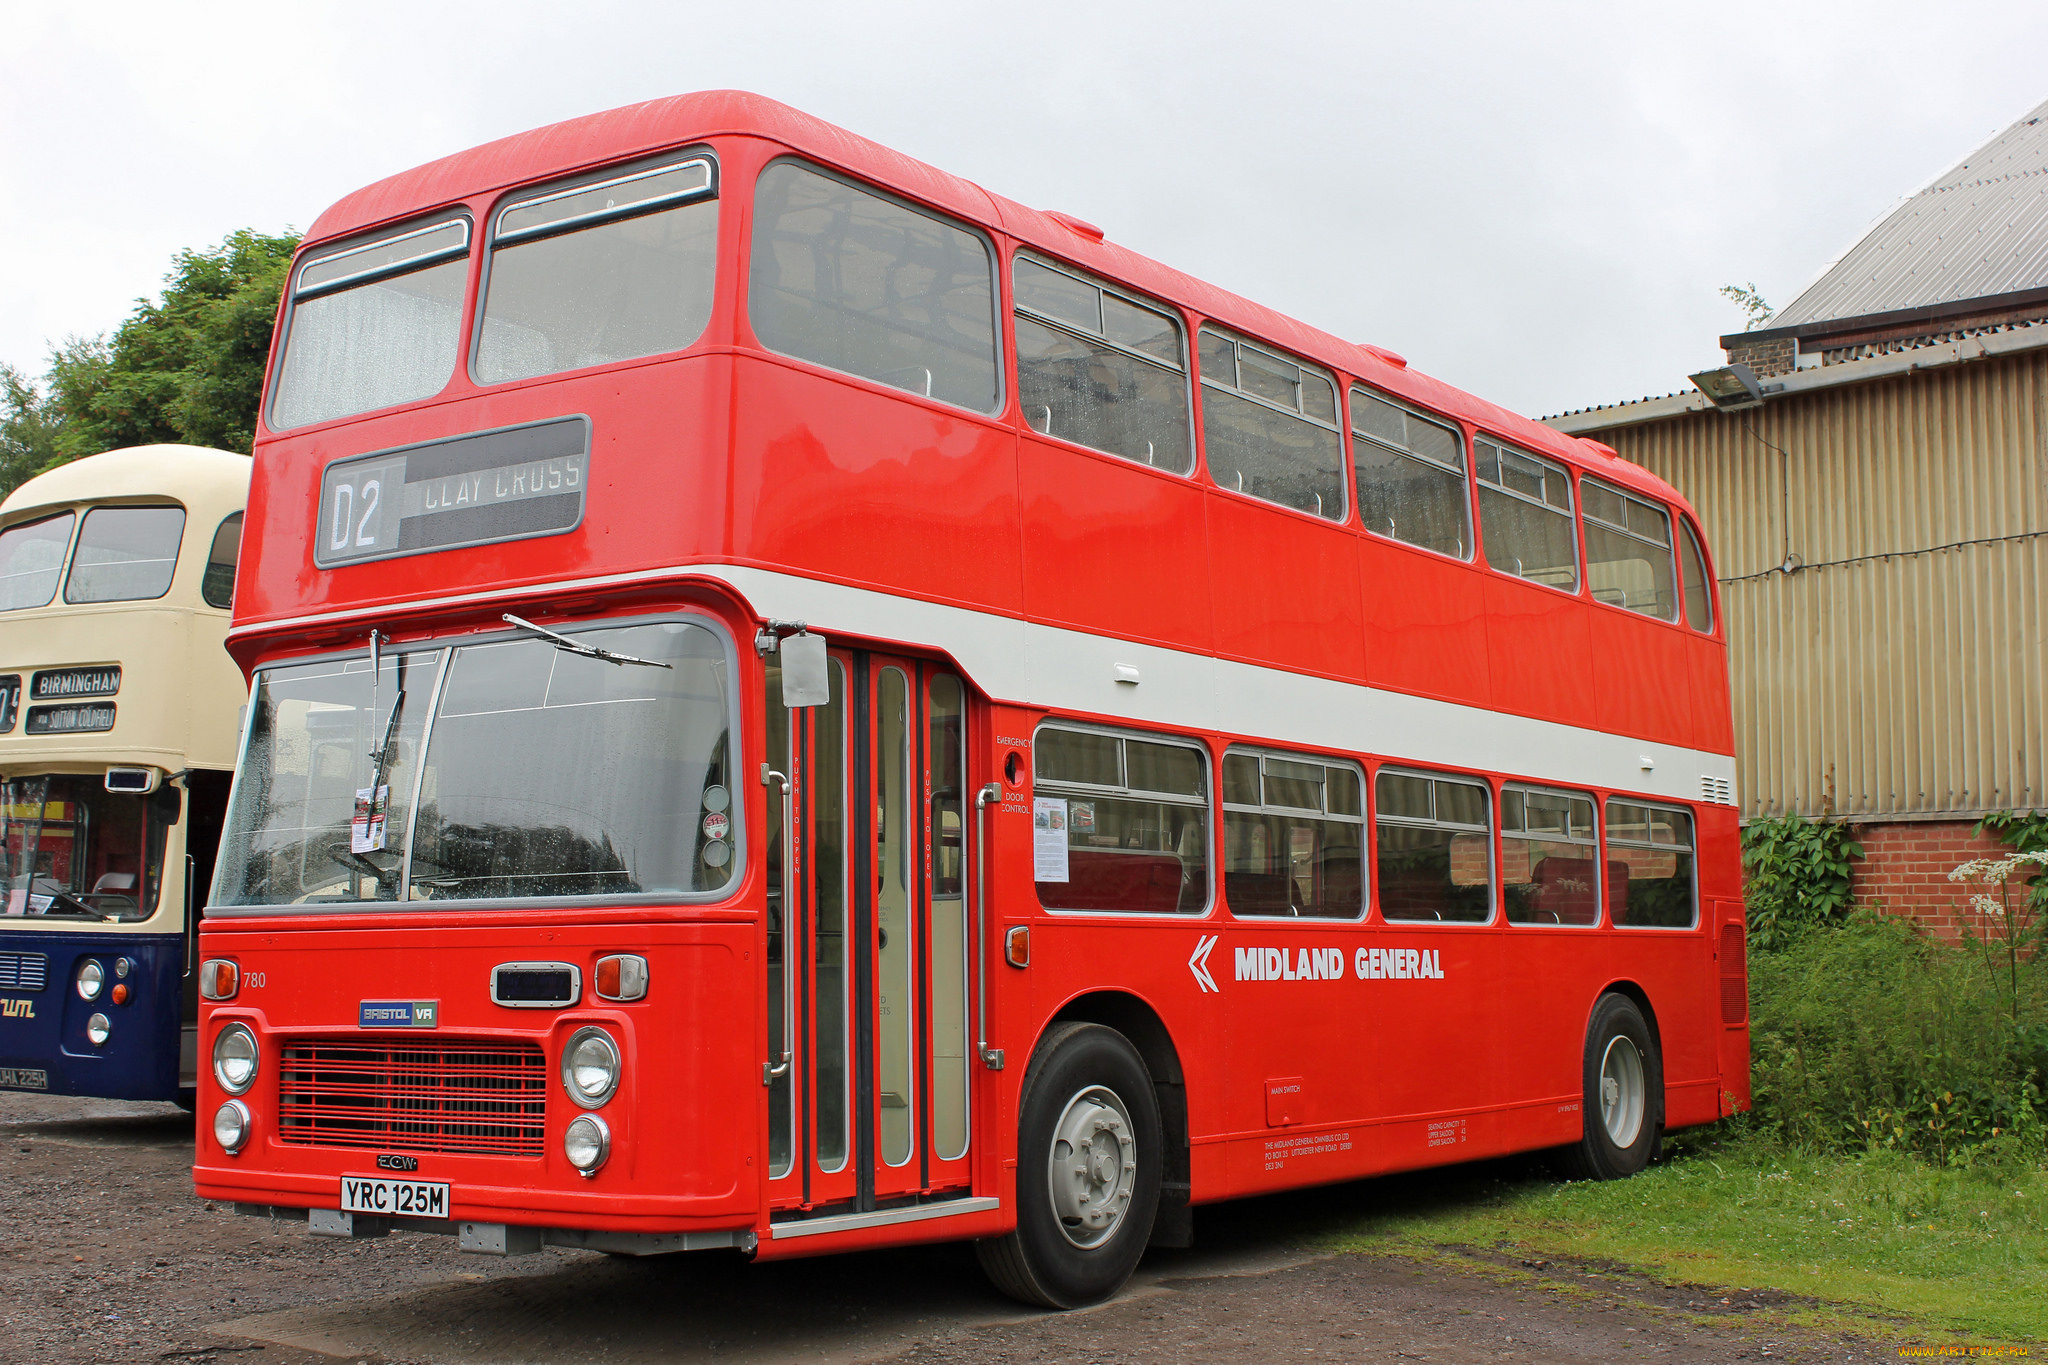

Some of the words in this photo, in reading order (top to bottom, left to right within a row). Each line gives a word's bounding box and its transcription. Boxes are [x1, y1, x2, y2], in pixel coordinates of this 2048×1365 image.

[425, 476, 481, 509] CLAY
[495, 458, 580, 498] CROSS
[331, 479, 380, 551] D2
[40, 672, 121, 694] BIRMINGHAM
[49, 709, 78, 728] SUTTON
[996, 735, 1032, 748] EMERGENCY
[1005, 792, 1025, 802] DOOR
[793, 807, 800, 824] TO
[1001, 803, 1031, 814] CONTROL
[925, 816, 931, 833] TO
[1234, 947, 1345, 981] MIDLAND
[1354, 947, 1445, 980] GENERAL
[243, 972, 266, 988] 780
[363, 1008, 410, 1020] BRISTOL
[415, 1008, 433, 1020] VR
[19, 1071, 47, 1087] 225H
[1271, 1086, 1284, 1095] MAIN
[1283, 1085, 1301, 1094] SWITCH
[1428, 1122, 1443, 1131] SEATING
[1443, 1120, 1460, 1128] CAPACITY
[1439, 1129, 1455, 1138] SALOON
[1264, 1142, 1274, 1150] THE
[1273, 1139, 1295, 1149] MIDLAND
[1294, 1137, 1314, 1146] GENERAL
[1314, 1134, 1334, 1144] OMNIBUS
[1334, 1133, 1341, 1142] CO
[1341, 1132, 1350, 1141] LTD
[1440, 1137, 1456, 1145] SALOON
[1264, 1152, 1272, 1160] PO
[1272, 1151, 1282, 1160] BOX
[1282, 1150, 1289, 1158] 35
[1291, 1147, 1315, 1156] UTTOXETER
[1315, 1145, 1325, 1154] NEW
[1325, 1143, 1338, 1152] ROAD
[1339, 1142, 1353, 1151] DERBY
[378, 1155, 415, 1170] ECW
[346, 1180, 388, 1210] YRC
[392, 1184, 444, 1214] 125M
